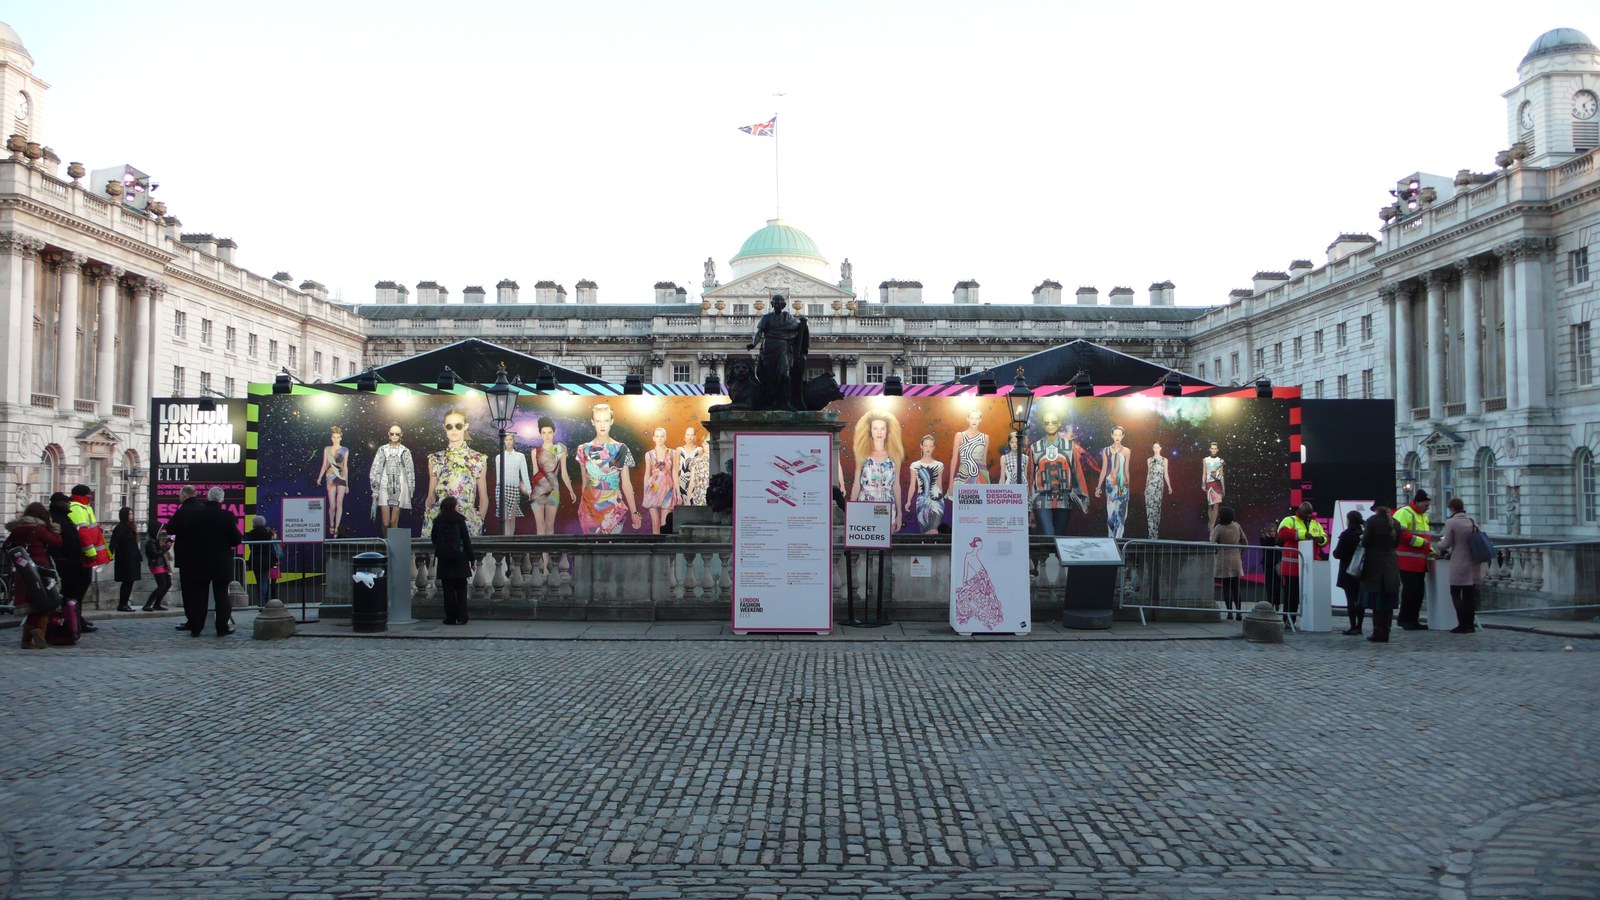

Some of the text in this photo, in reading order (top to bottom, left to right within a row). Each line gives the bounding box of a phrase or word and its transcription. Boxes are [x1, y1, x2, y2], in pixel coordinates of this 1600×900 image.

[159, 403, 229, 424] LONDON
[158, 423, 234, 444] FASHION
[158, 443, 241, 464] WEEKEND
[157, 468, 190, 481] ELLE
[848, 533, 886, 541] HOLDERS
